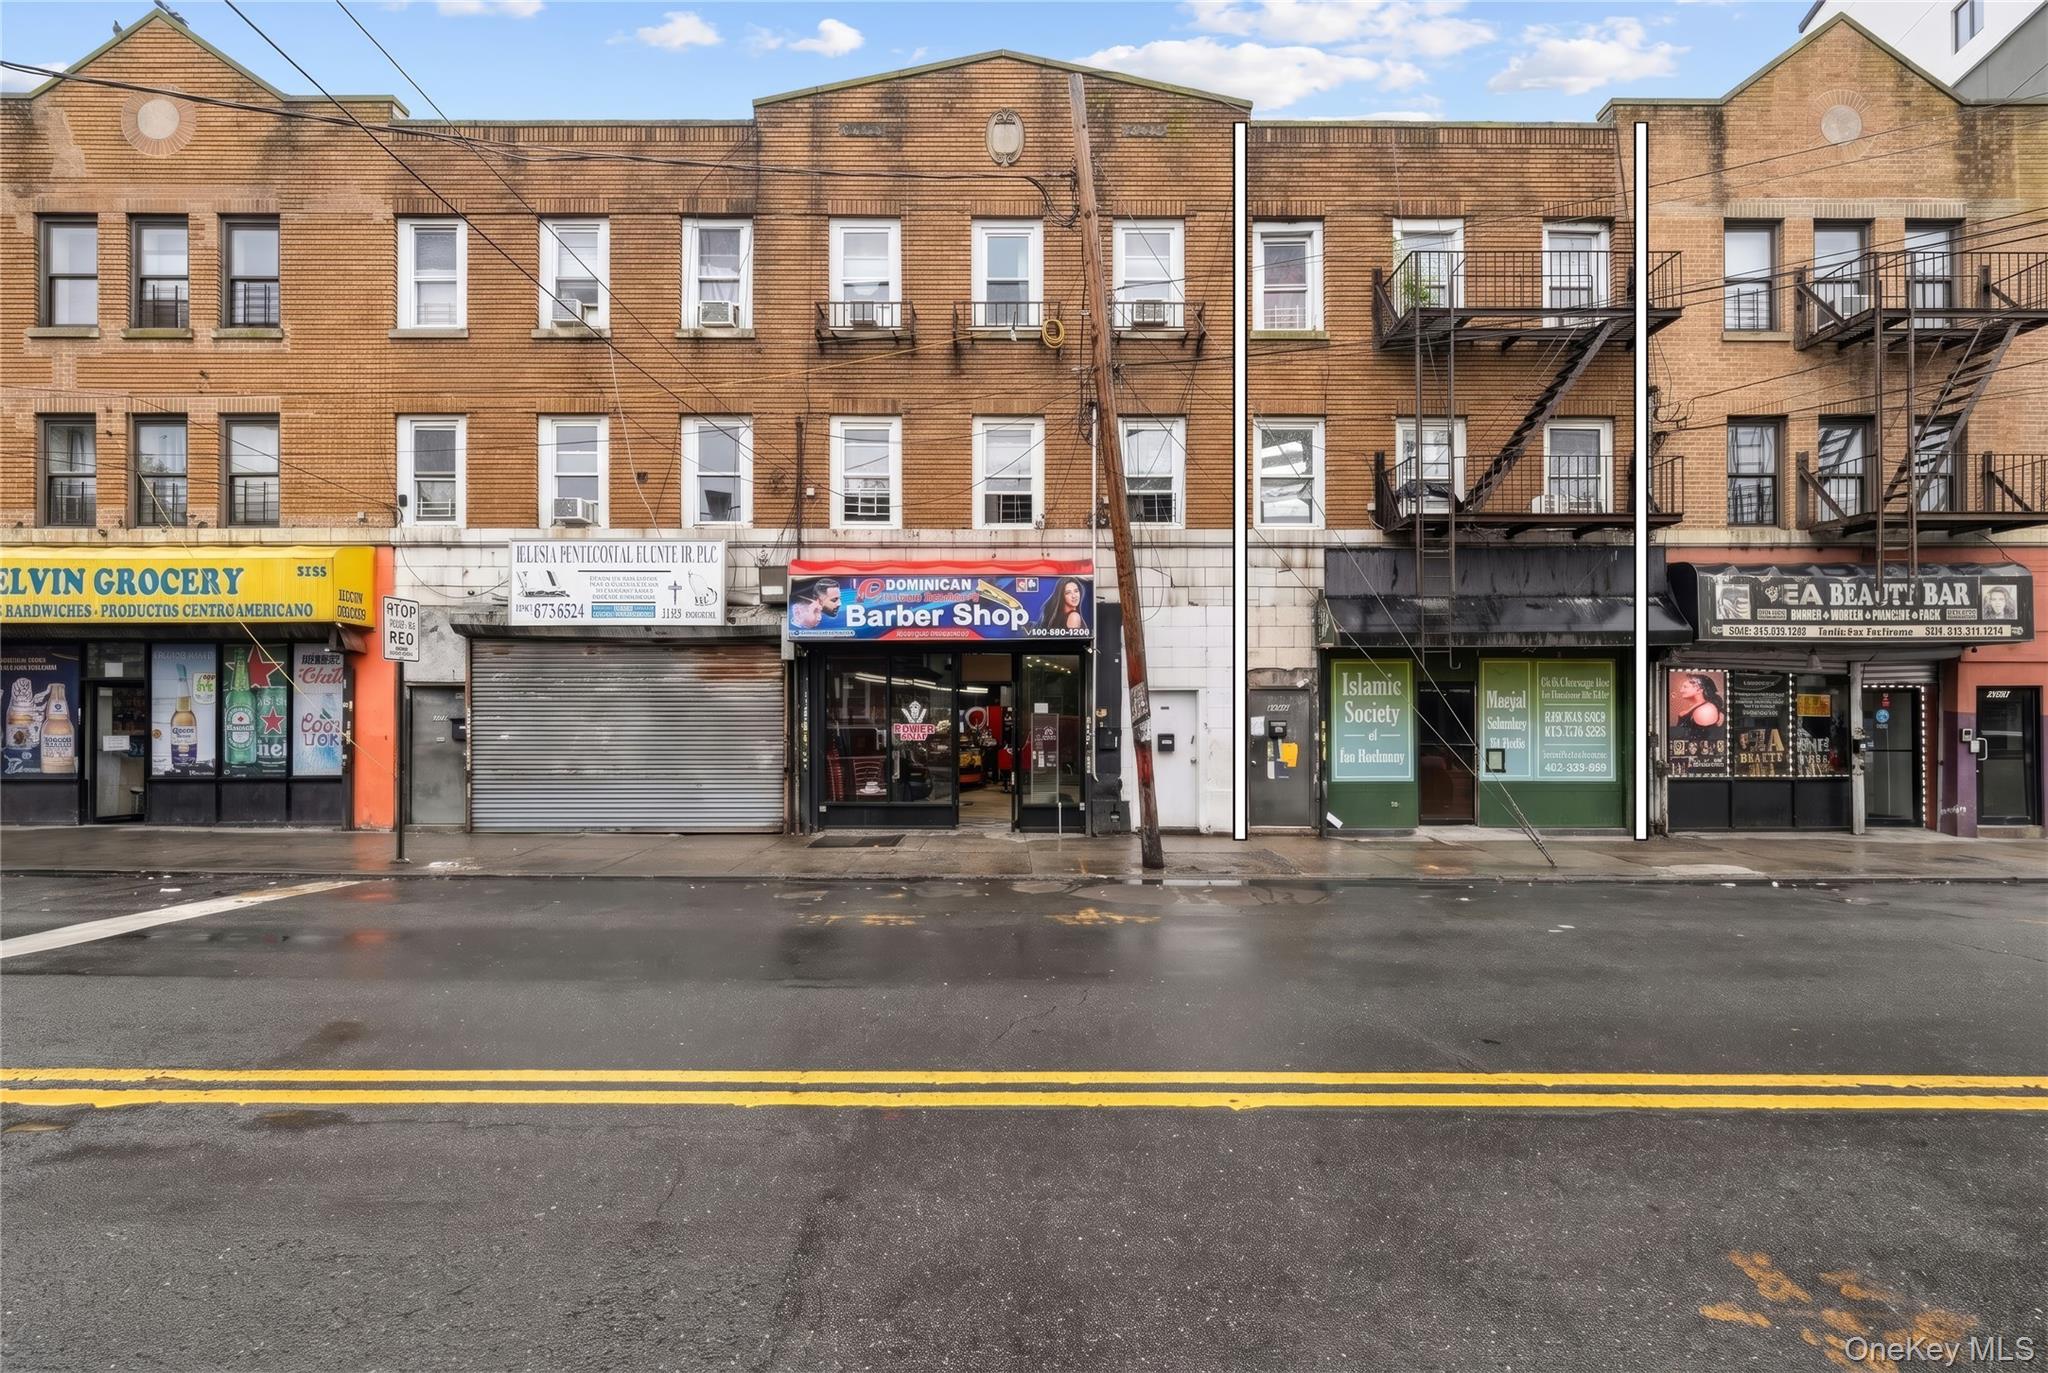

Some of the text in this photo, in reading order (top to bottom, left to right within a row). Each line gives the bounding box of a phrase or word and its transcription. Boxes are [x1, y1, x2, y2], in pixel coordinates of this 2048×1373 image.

[94, 567, 244, 596] GROCERY
[886, 579, 971, 591] DOMINICAN
[1923, 583, 1970, 606] BAR
[846, 603, 1029, 631] Barber Shop
[1342, 672, 1402, 696] Islamic
[1344, 700, 1400, 727] Society
